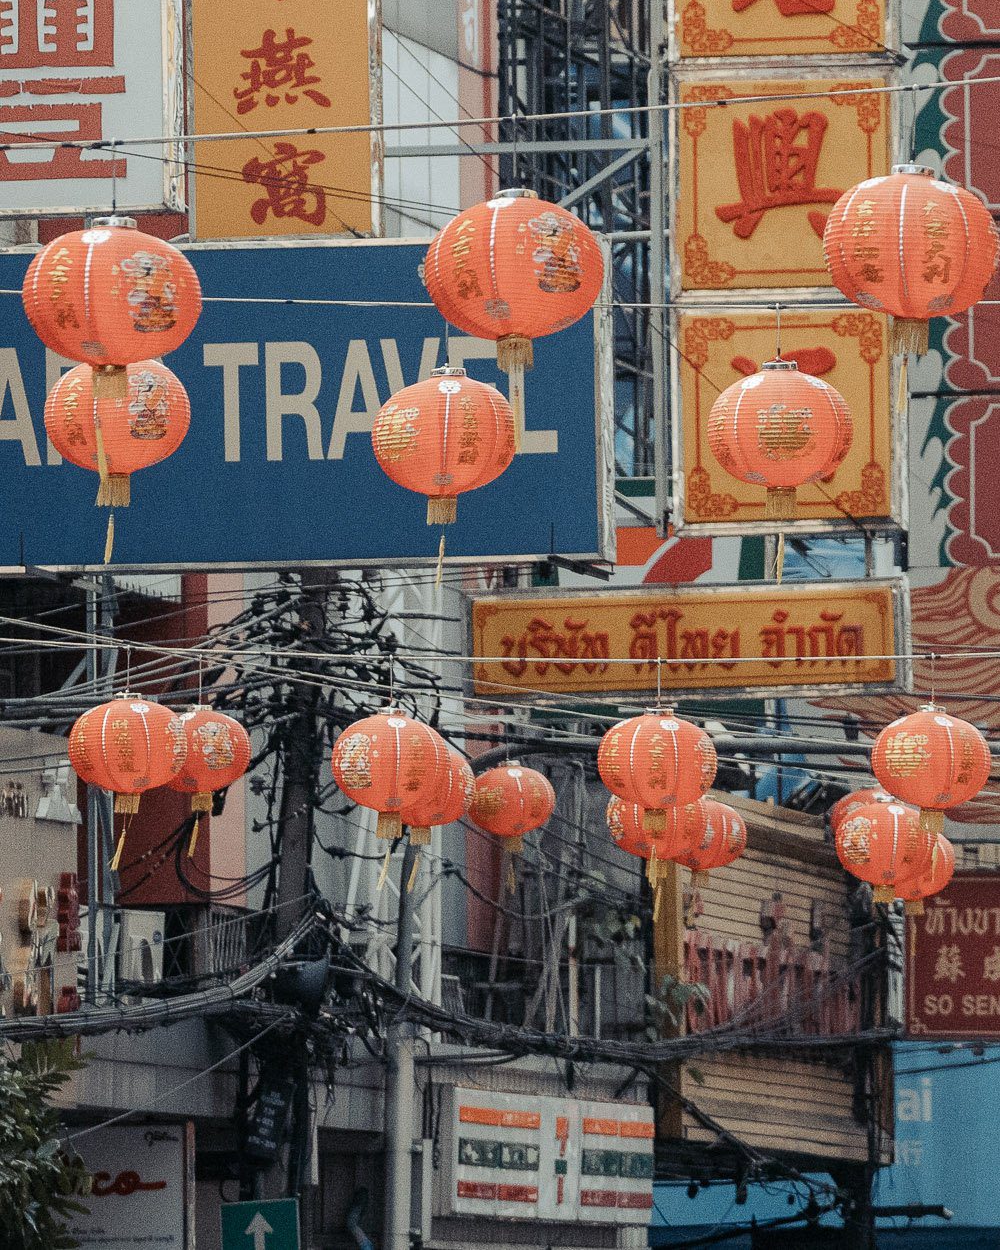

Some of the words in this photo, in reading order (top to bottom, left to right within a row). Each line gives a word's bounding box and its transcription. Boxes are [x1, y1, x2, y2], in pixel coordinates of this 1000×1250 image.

[203, 335, 559, 463] TRAL
[501, 615, 609, 676] บริษัท
[924, 994, 953, 1016] SO
